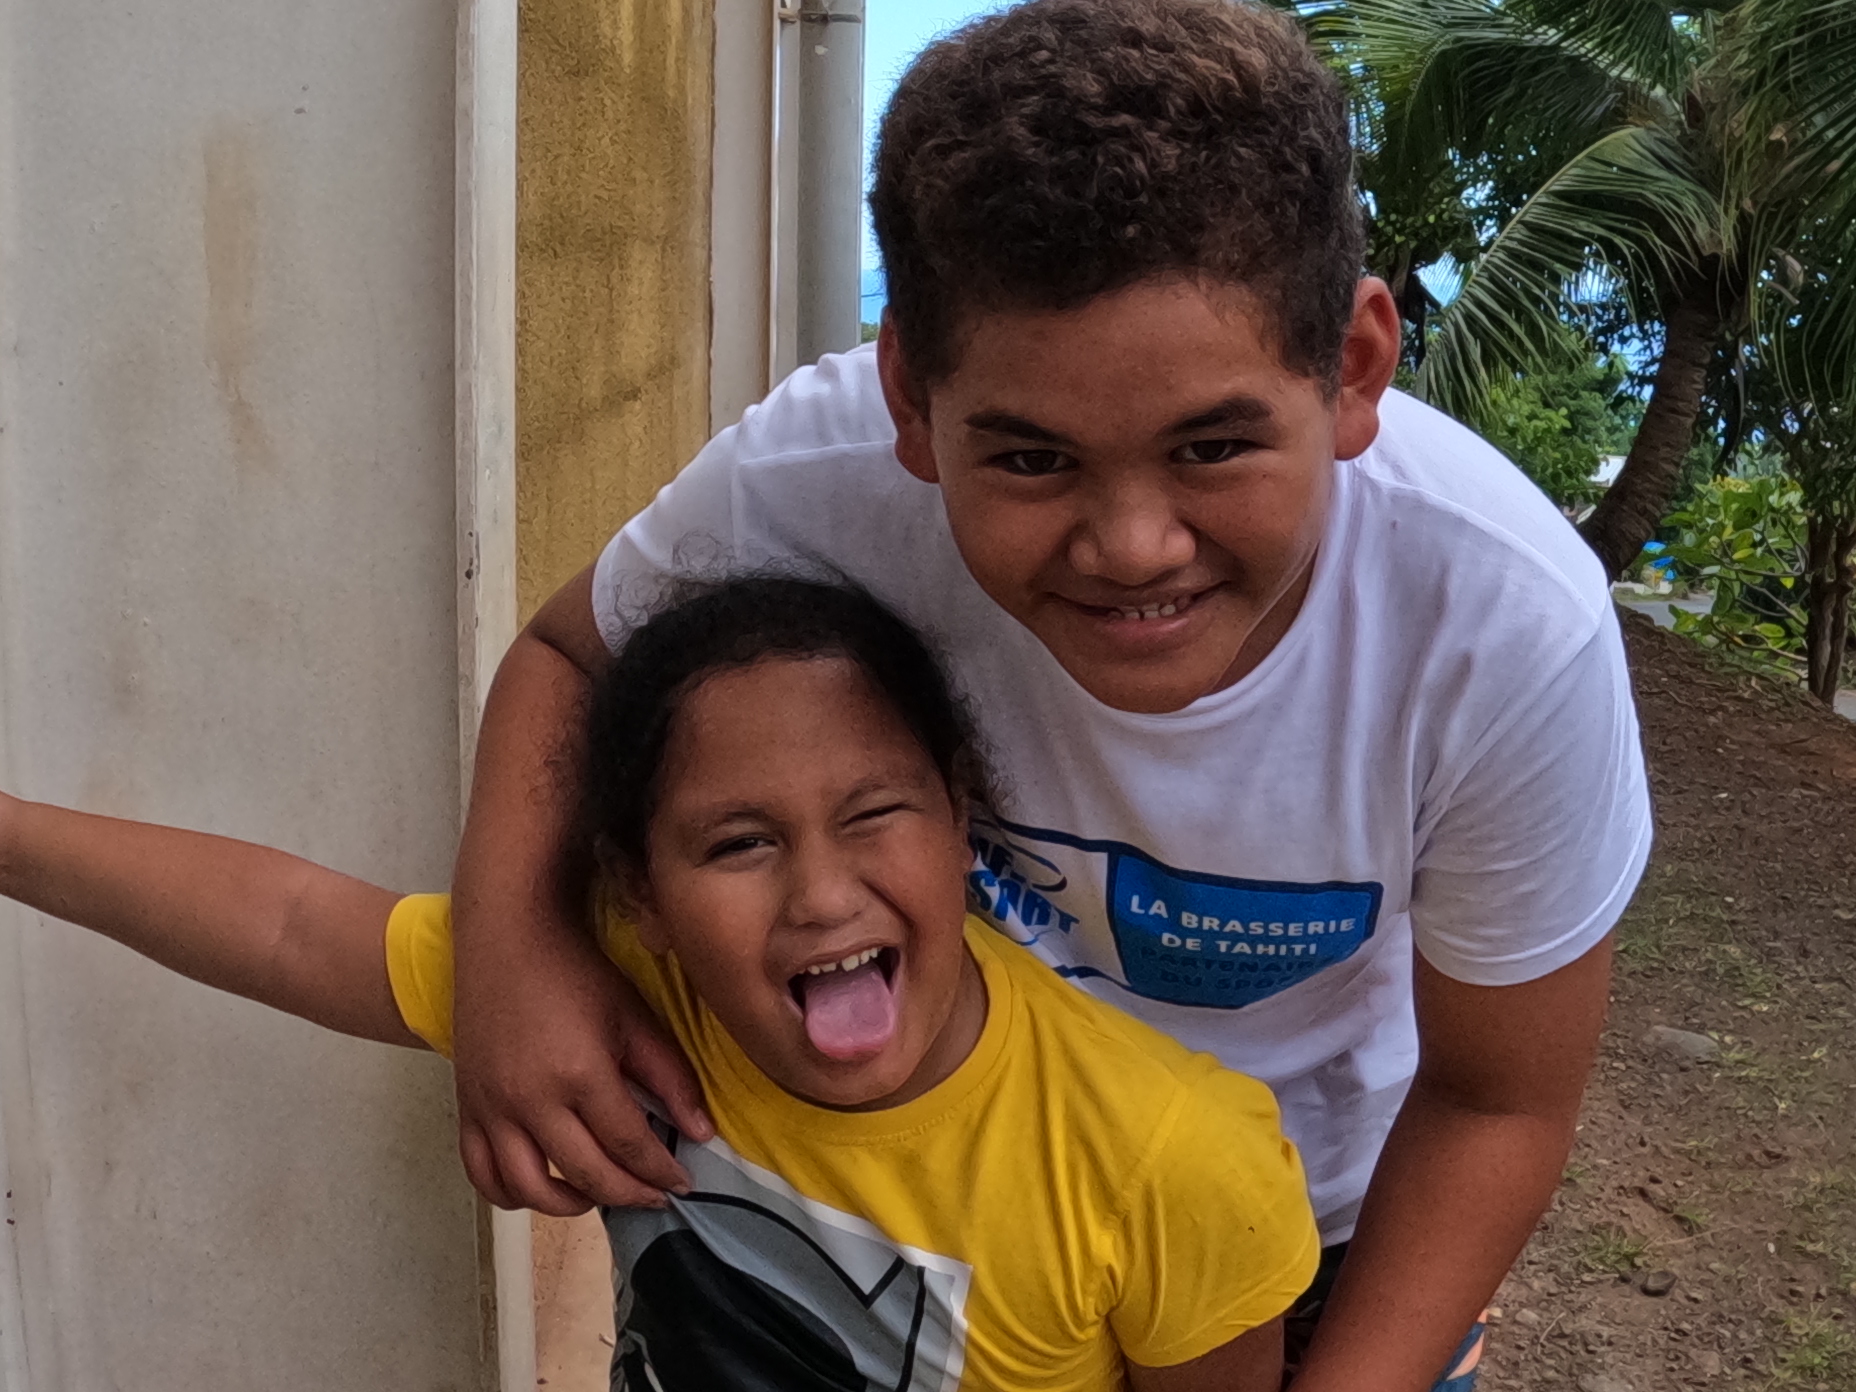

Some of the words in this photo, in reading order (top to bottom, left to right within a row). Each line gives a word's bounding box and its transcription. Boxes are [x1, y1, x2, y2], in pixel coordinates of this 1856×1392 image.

[1129, 894, 1169, 919] LA
[1181, 912, 1357, 937] BRASSERIE
[1161, 932, 1202, 952] DE
[1216, 940, 1317, 956] TAHITI
